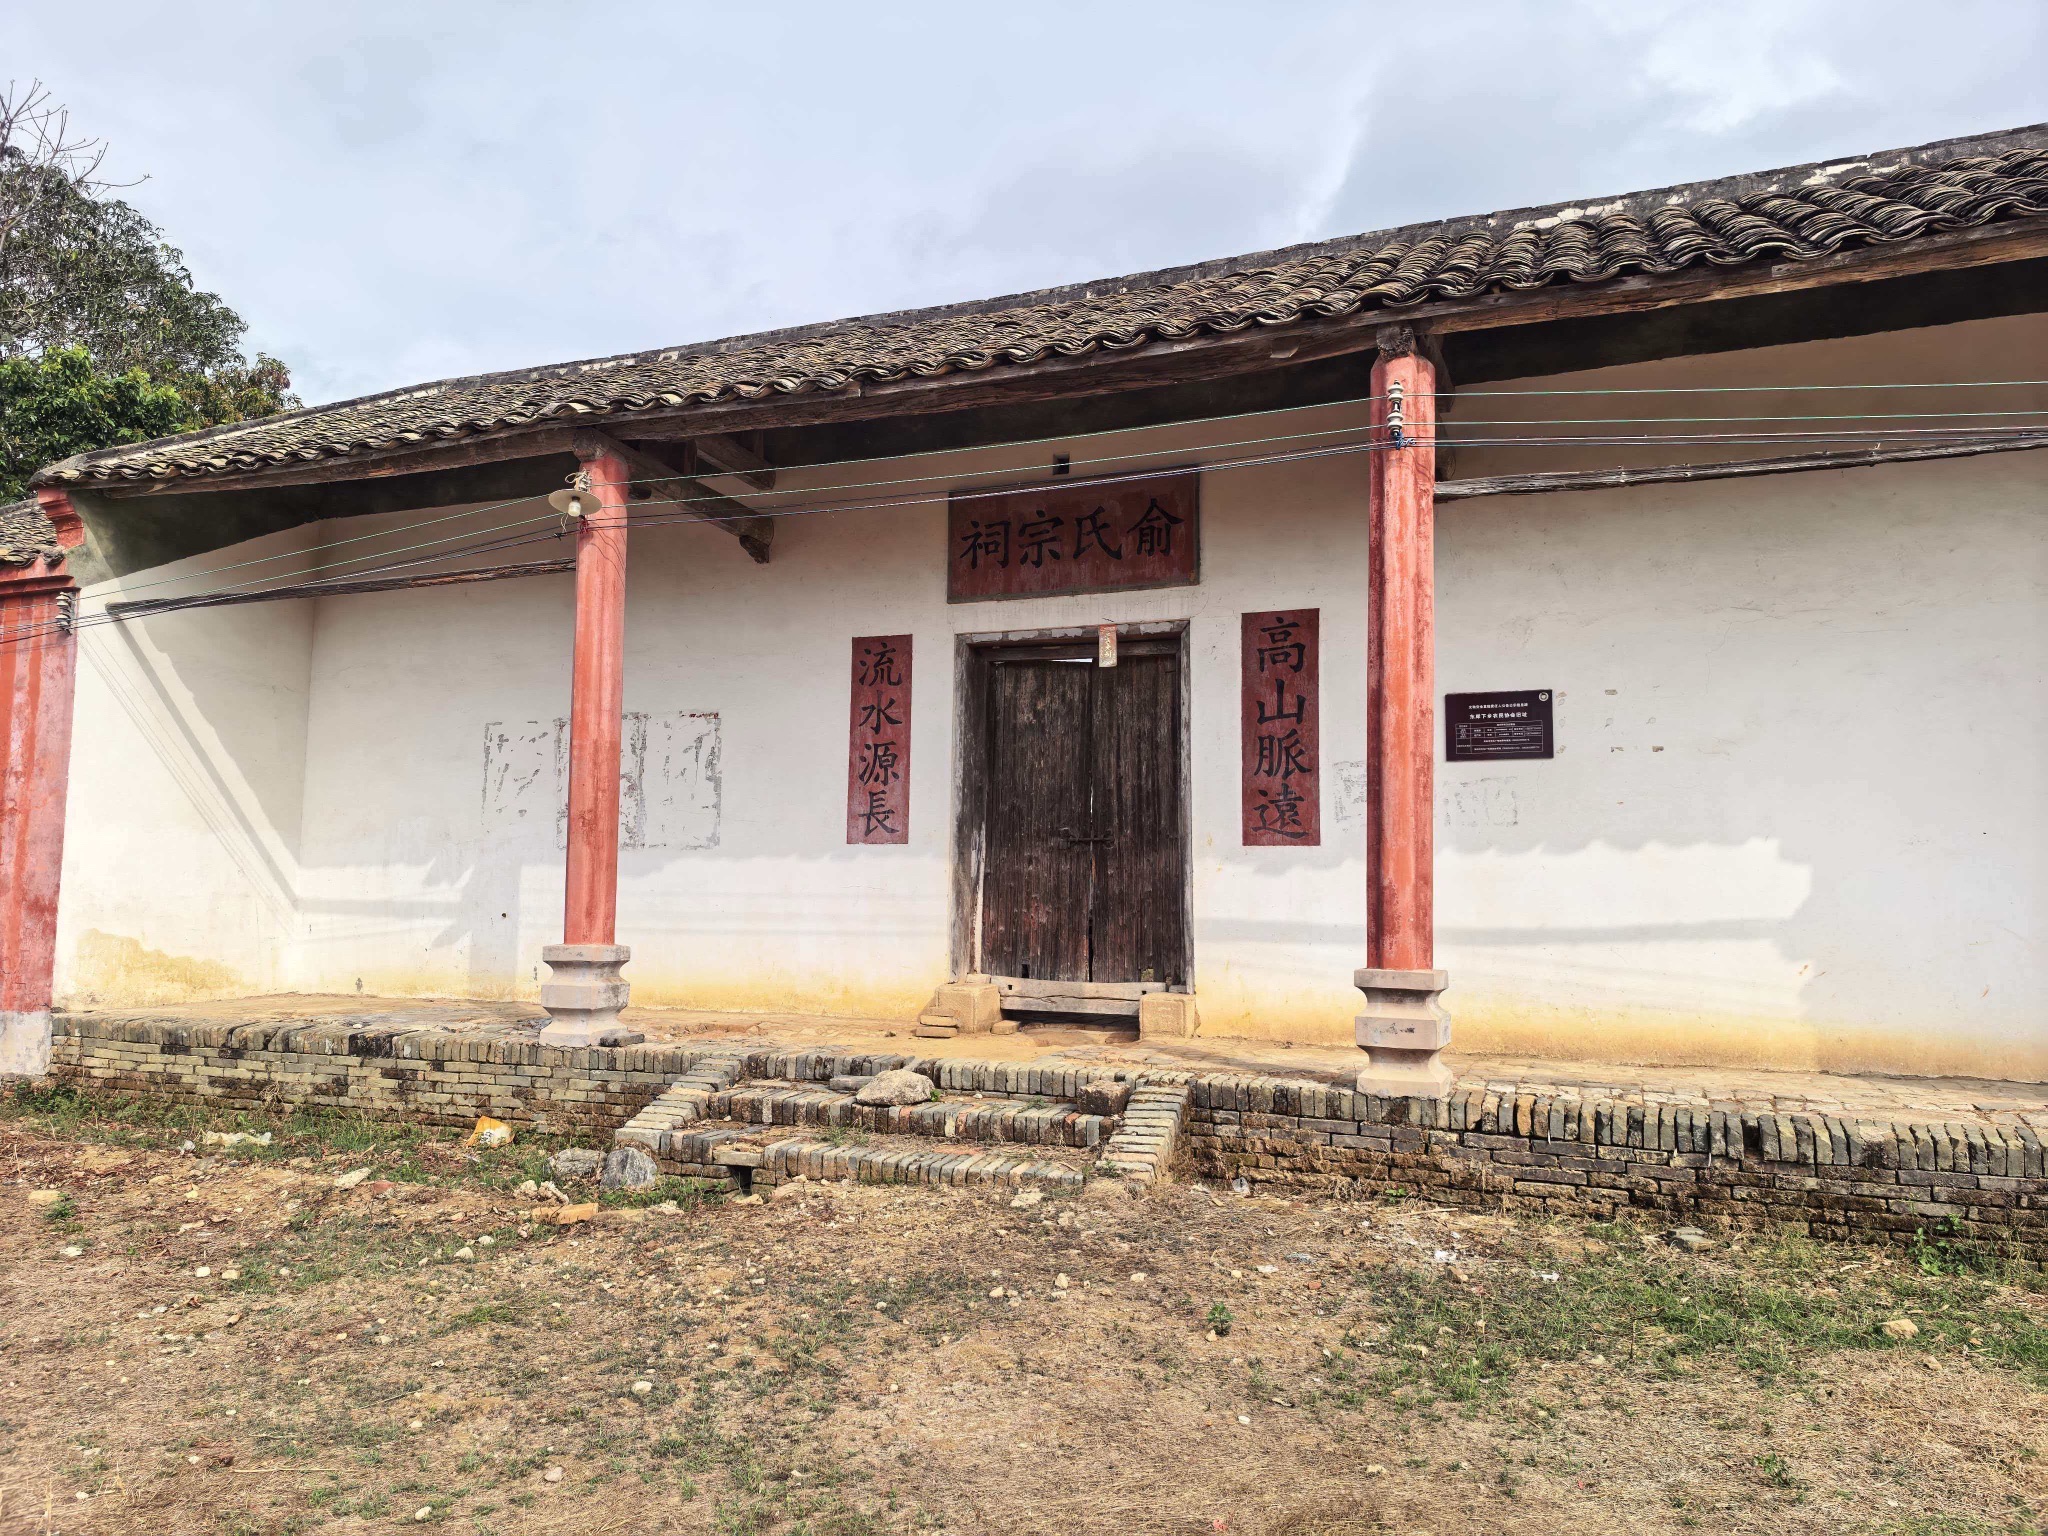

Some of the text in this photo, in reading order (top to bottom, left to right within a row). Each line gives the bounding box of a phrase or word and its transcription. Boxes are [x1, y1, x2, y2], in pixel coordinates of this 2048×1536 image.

[858, 642, 902, 838] 流水源長
[1251, 616, 1312, 839] 高山脈遠
